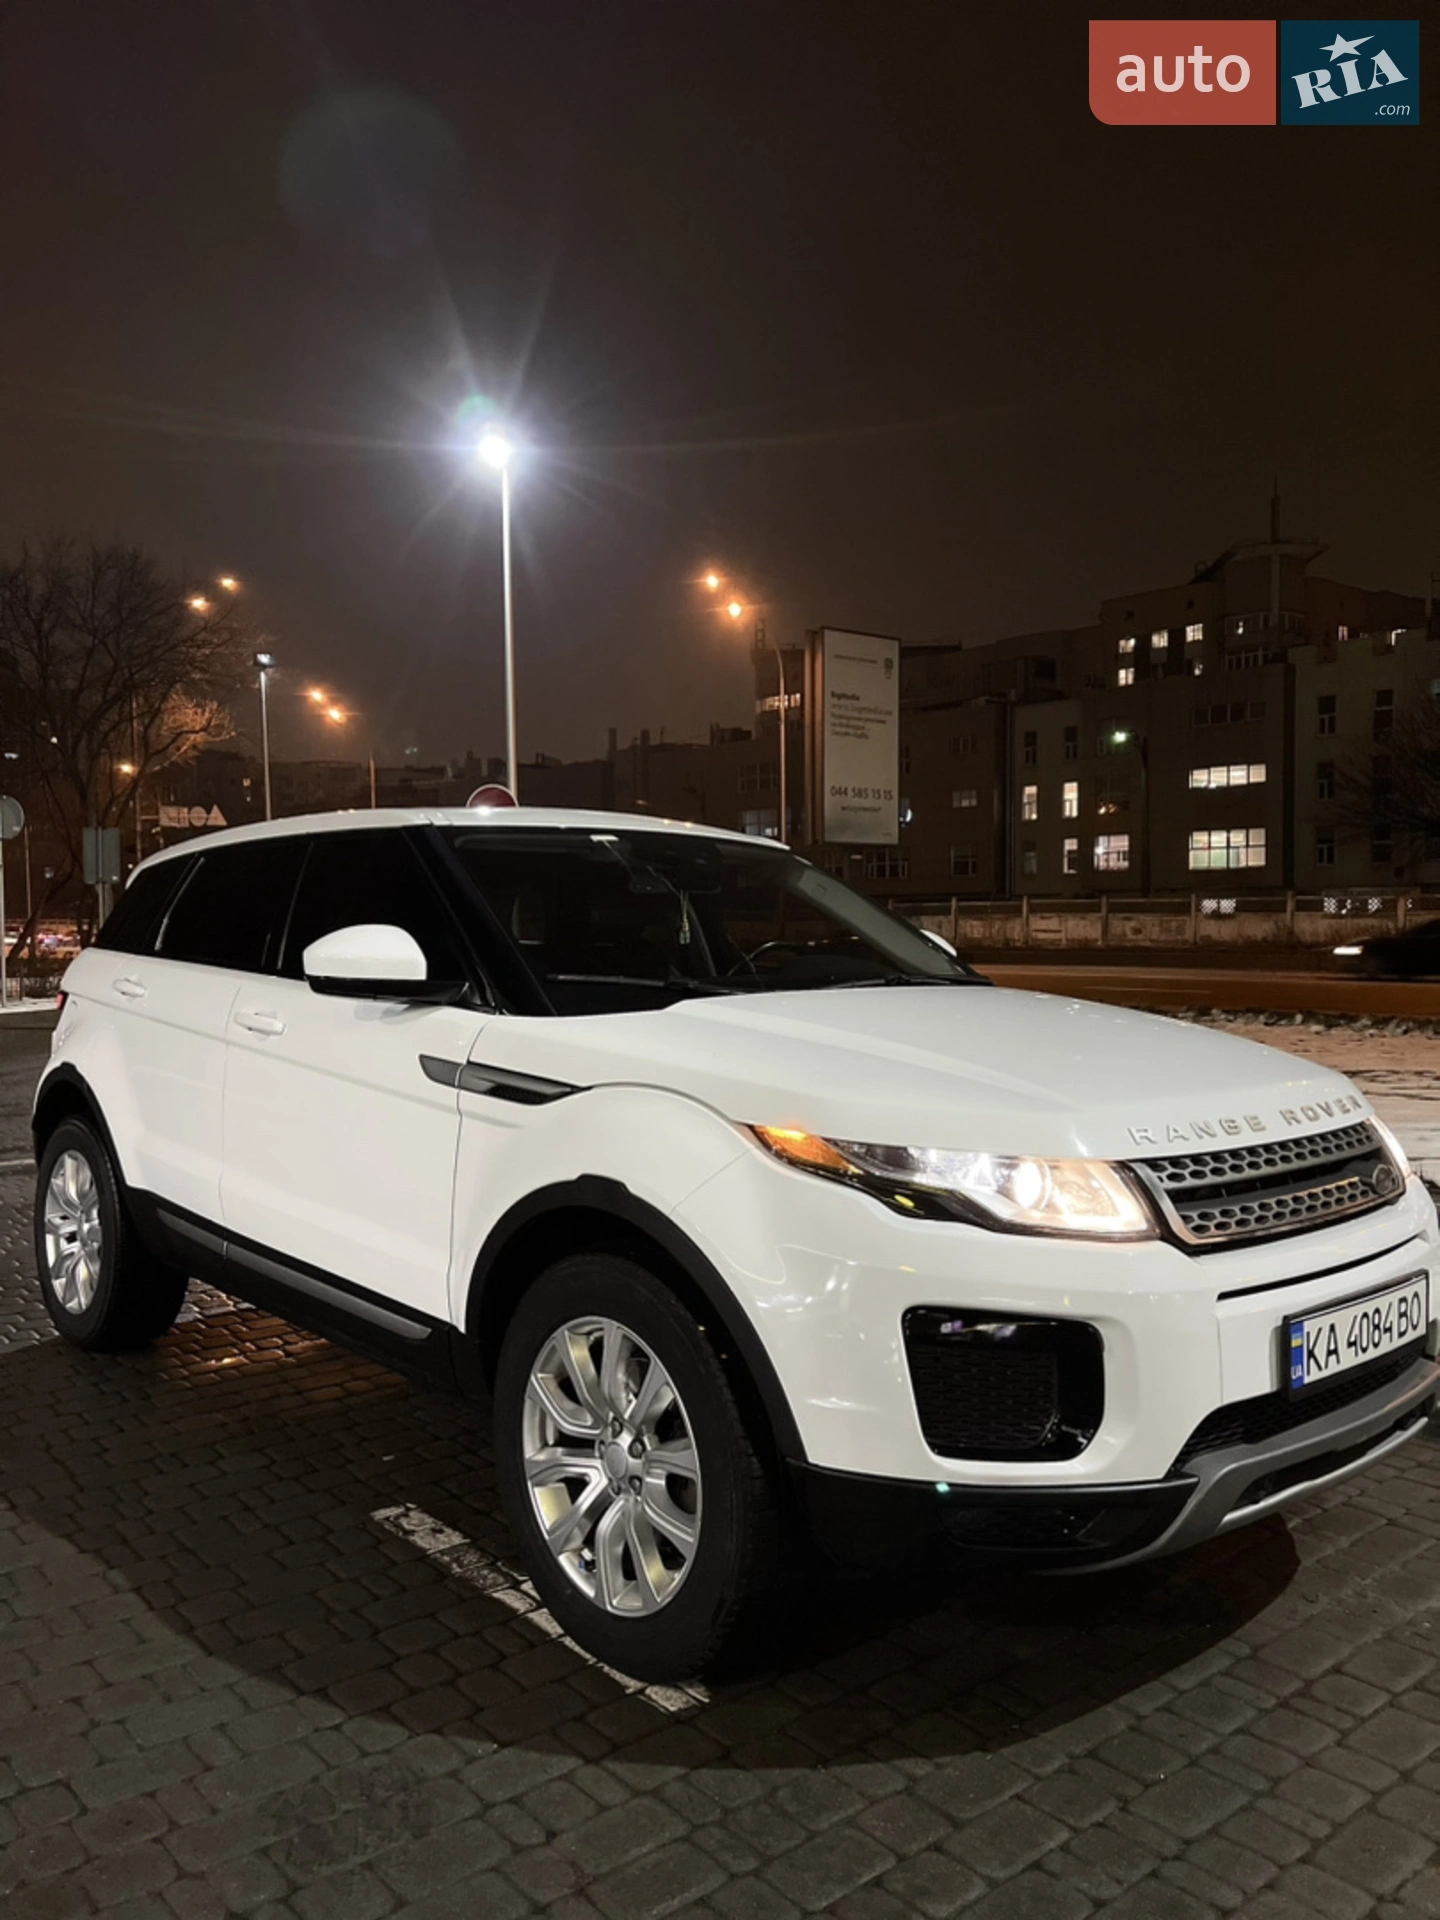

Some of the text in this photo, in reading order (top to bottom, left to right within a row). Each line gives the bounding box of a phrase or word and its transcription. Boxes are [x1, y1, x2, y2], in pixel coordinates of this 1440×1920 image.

[829, 785, 893, 801] 044 585 15 15
[1127, 1094, 1363, 1146] RANGE ROVER
[1306, 1290, 1421, 1376] KA 4084 BO
